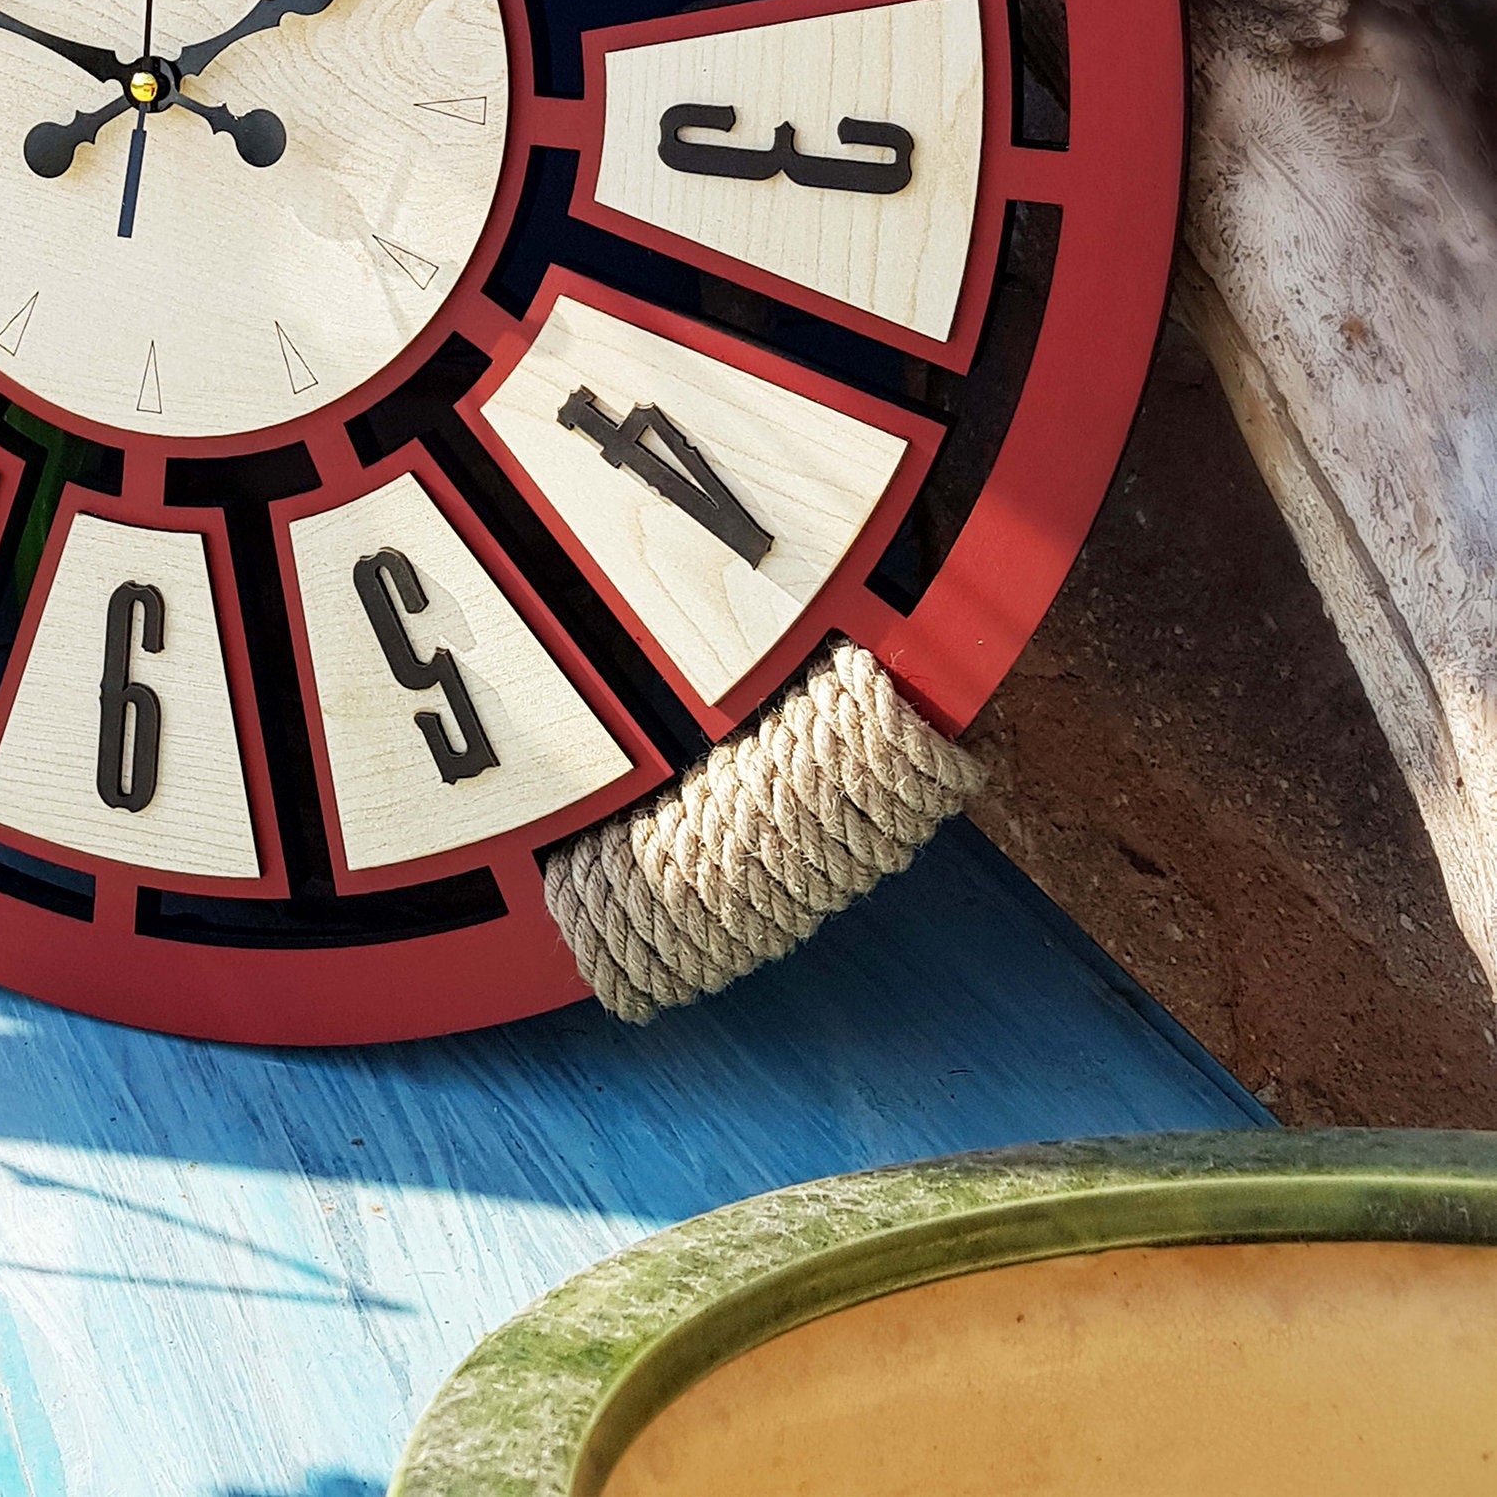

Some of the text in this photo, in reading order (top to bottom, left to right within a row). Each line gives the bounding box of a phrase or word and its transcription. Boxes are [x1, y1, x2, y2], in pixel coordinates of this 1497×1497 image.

[657, 103, 916, 195] 3
[556, 384, 776, 571] 4
[96, 579, 167, 814] 6
[353, 546, 501, 786] 5
